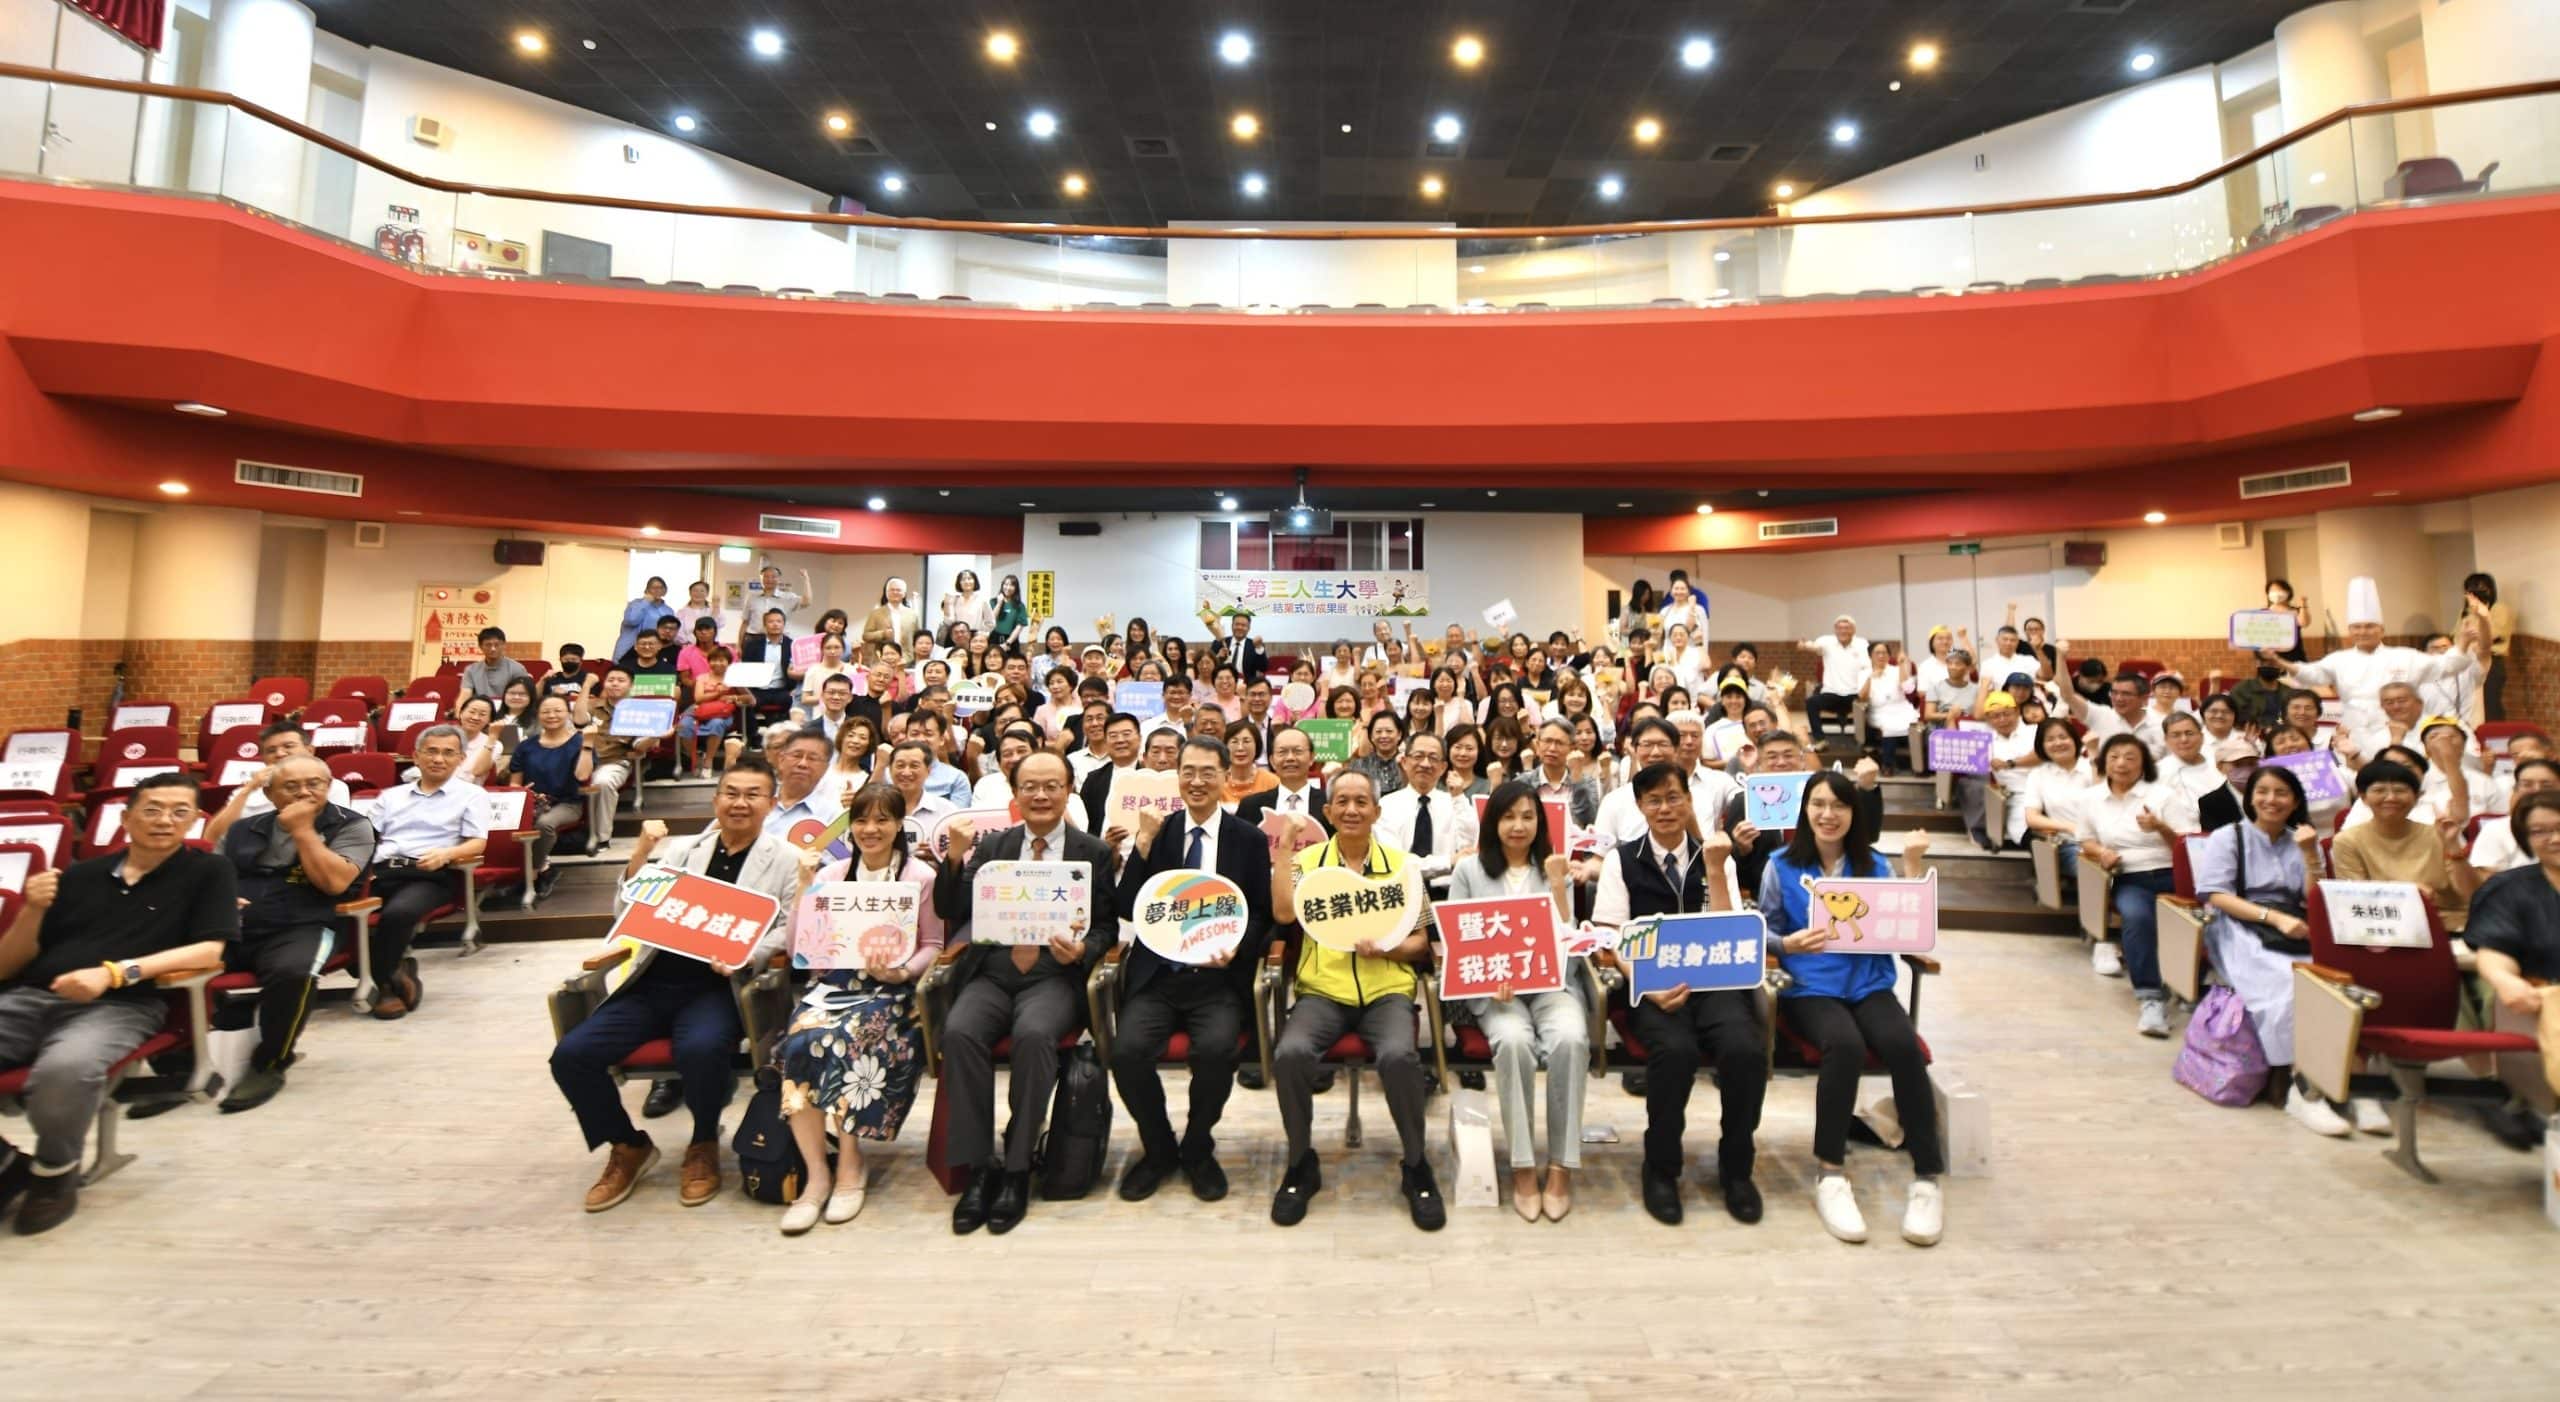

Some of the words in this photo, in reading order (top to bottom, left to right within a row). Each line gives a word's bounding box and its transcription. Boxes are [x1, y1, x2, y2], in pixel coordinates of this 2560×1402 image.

[1245, 579, 1379, 599] 第三人生大學
[442, 612, 488, 625] 消防栓
[1272, 602, 1348, 614] 結業式暨成果展
[814, 896, 913, 912] 第三人生大學
[980, 885, 1085, 902] 第三人生大學
[1303, 883, 1405, 924] 結業快樂
[653, 896, 762, 946] 終身成長
[1145, 895, 1237, 925] 夢想上線
[1179, 920, 1240, 953] AWESOME
[1656, 938, 1758, 969] 終身成長
